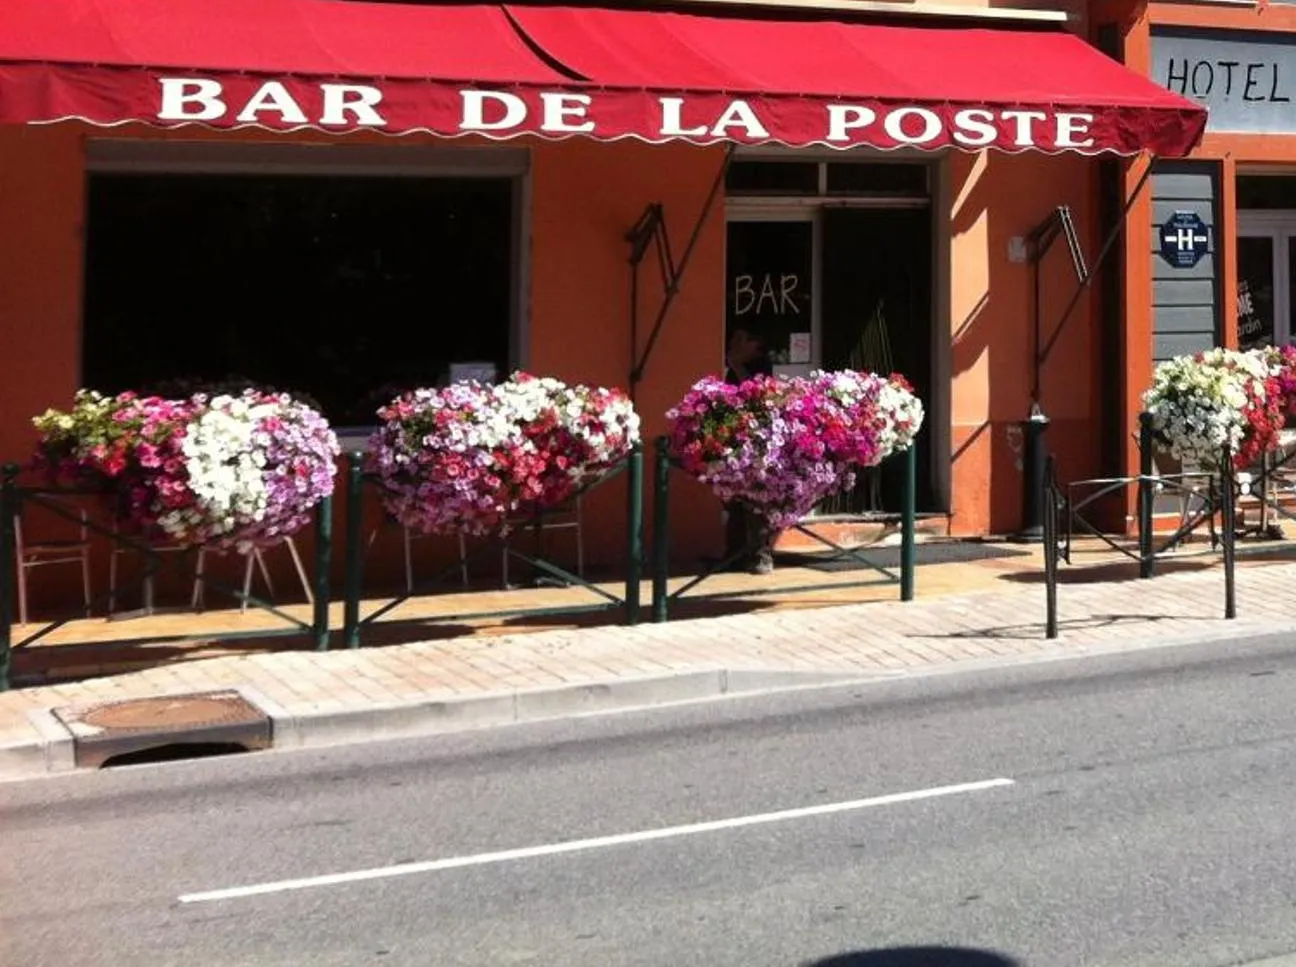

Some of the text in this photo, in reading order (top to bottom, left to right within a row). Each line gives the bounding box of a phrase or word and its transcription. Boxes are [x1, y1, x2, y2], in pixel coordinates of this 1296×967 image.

[1167, 58, 1290, 103] HOTEL
[157, 77, 1096, 147] BAR DE LA POSTE
[735, 274, 800, 315] BAR
